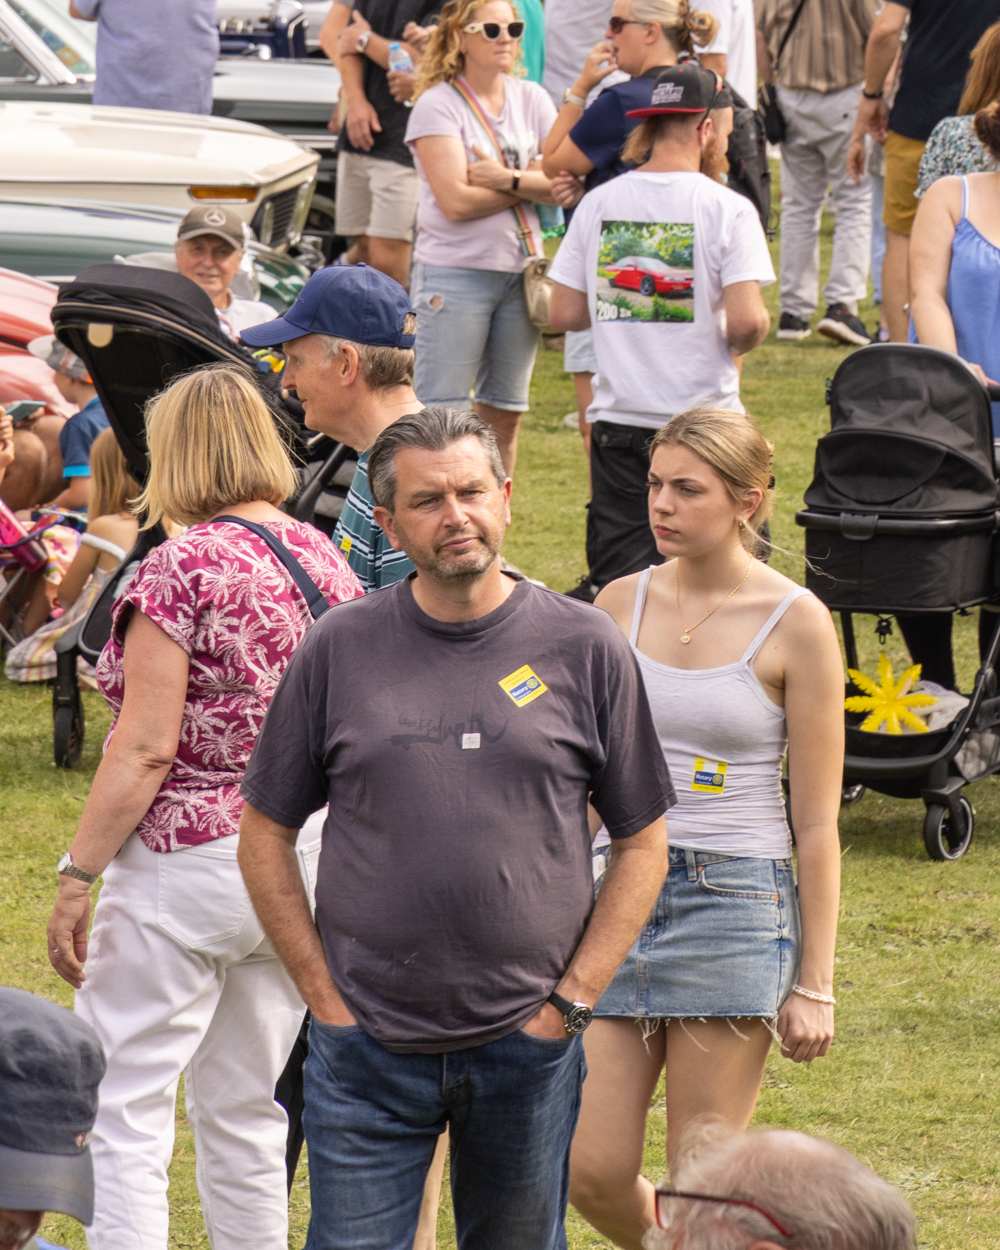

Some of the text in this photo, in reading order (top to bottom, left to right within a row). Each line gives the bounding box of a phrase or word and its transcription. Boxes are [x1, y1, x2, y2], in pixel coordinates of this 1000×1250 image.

[597, 300, 618, 321] 200
[511, 685, 529, 697] Rotary
[695, 773, 713, 782] Rotary
